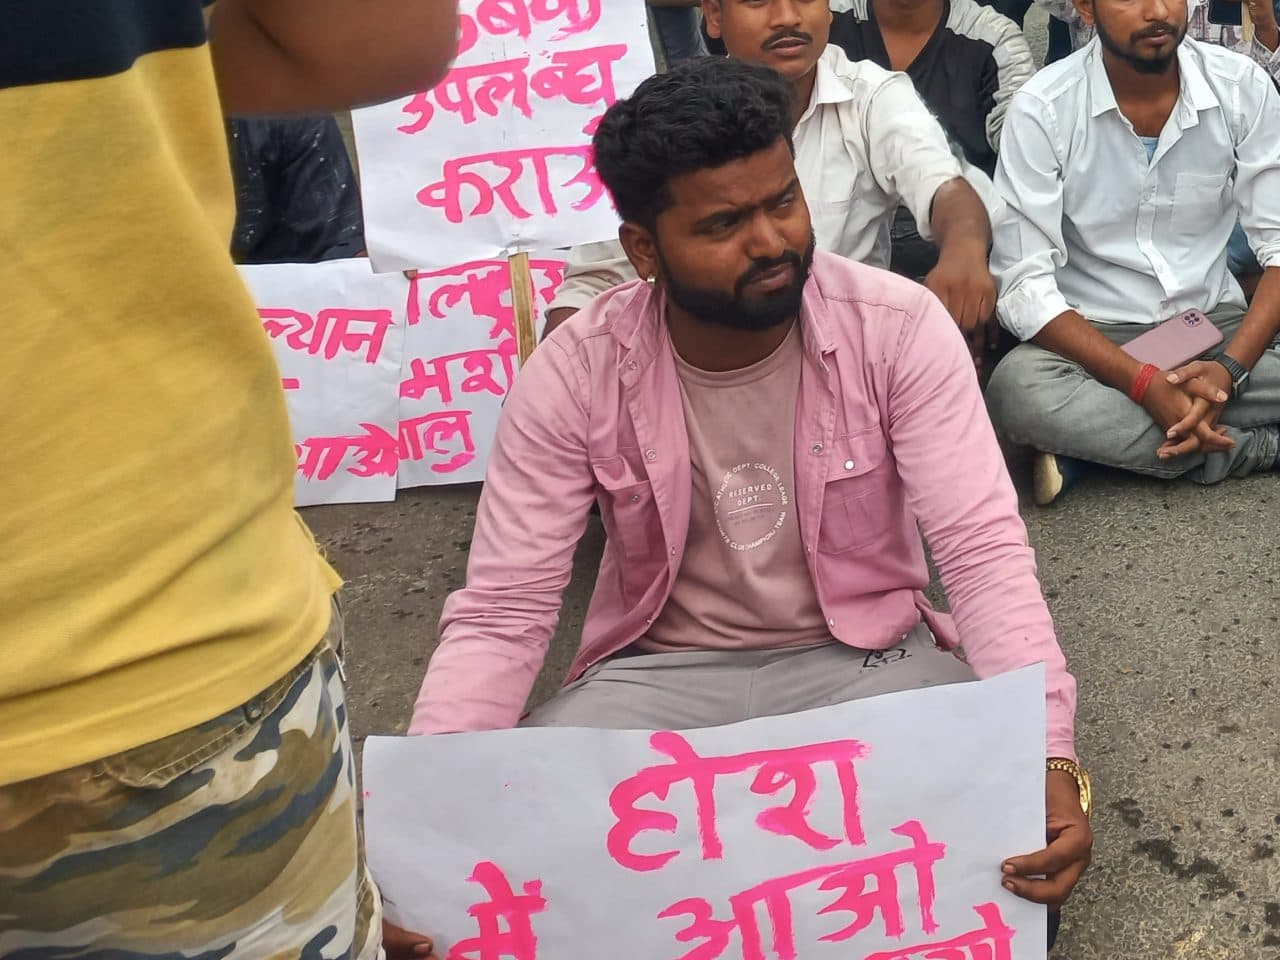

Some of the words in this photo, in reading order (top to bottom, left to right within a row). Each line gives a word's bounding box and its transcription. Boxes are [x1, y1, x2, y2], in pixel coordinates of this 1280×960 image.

[728, 483, 773, 499] RESERVED
[606, 731, 871, 872] होश
[656, 820, 947, 960] आओ
